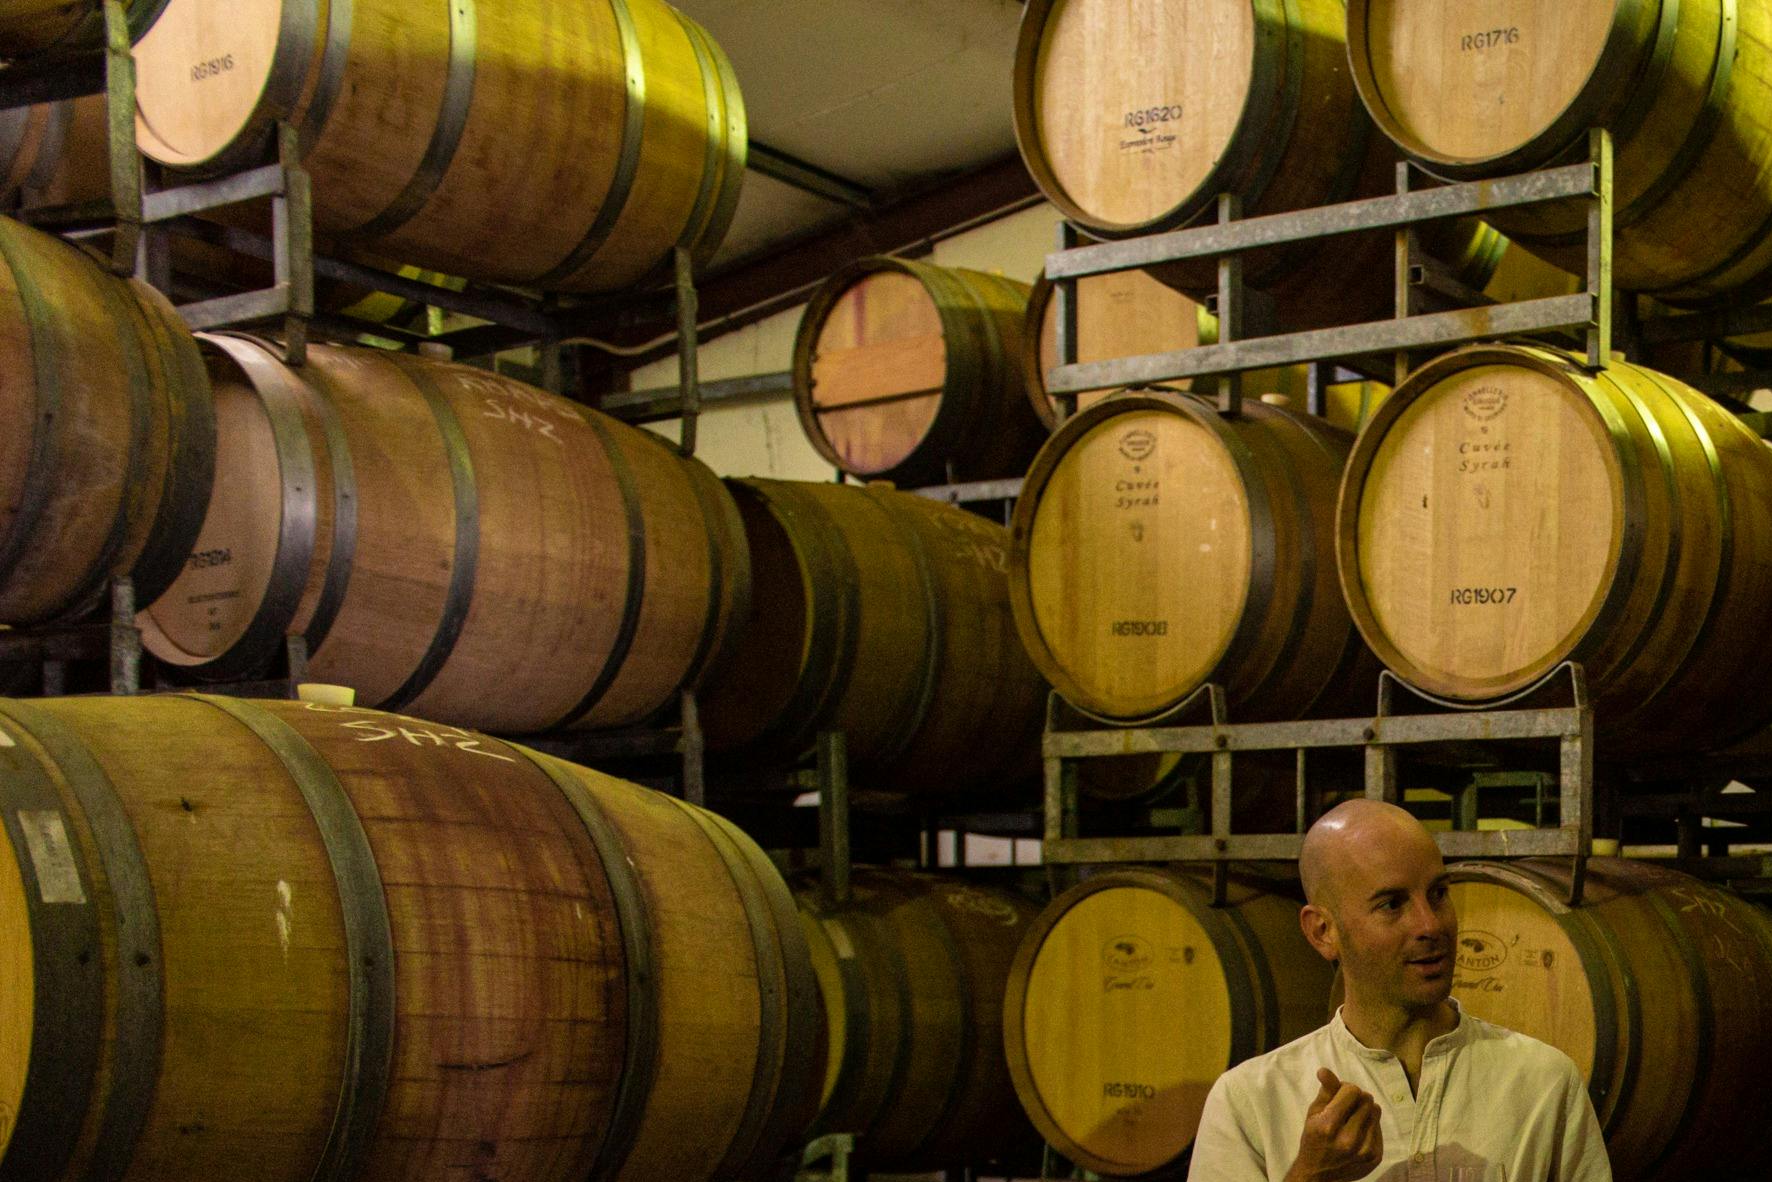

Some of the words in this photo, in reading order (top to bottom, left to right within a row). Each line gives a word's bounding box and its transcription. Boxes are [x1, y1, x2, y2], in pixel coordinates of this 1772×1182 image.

[1124, 104, 1183, 128] RG1620
[1459, 457, 1511, 474] Syrah
[1450, 587, 1517, 605] RG1907
[1457, 954, 1500, 968] ANTON
